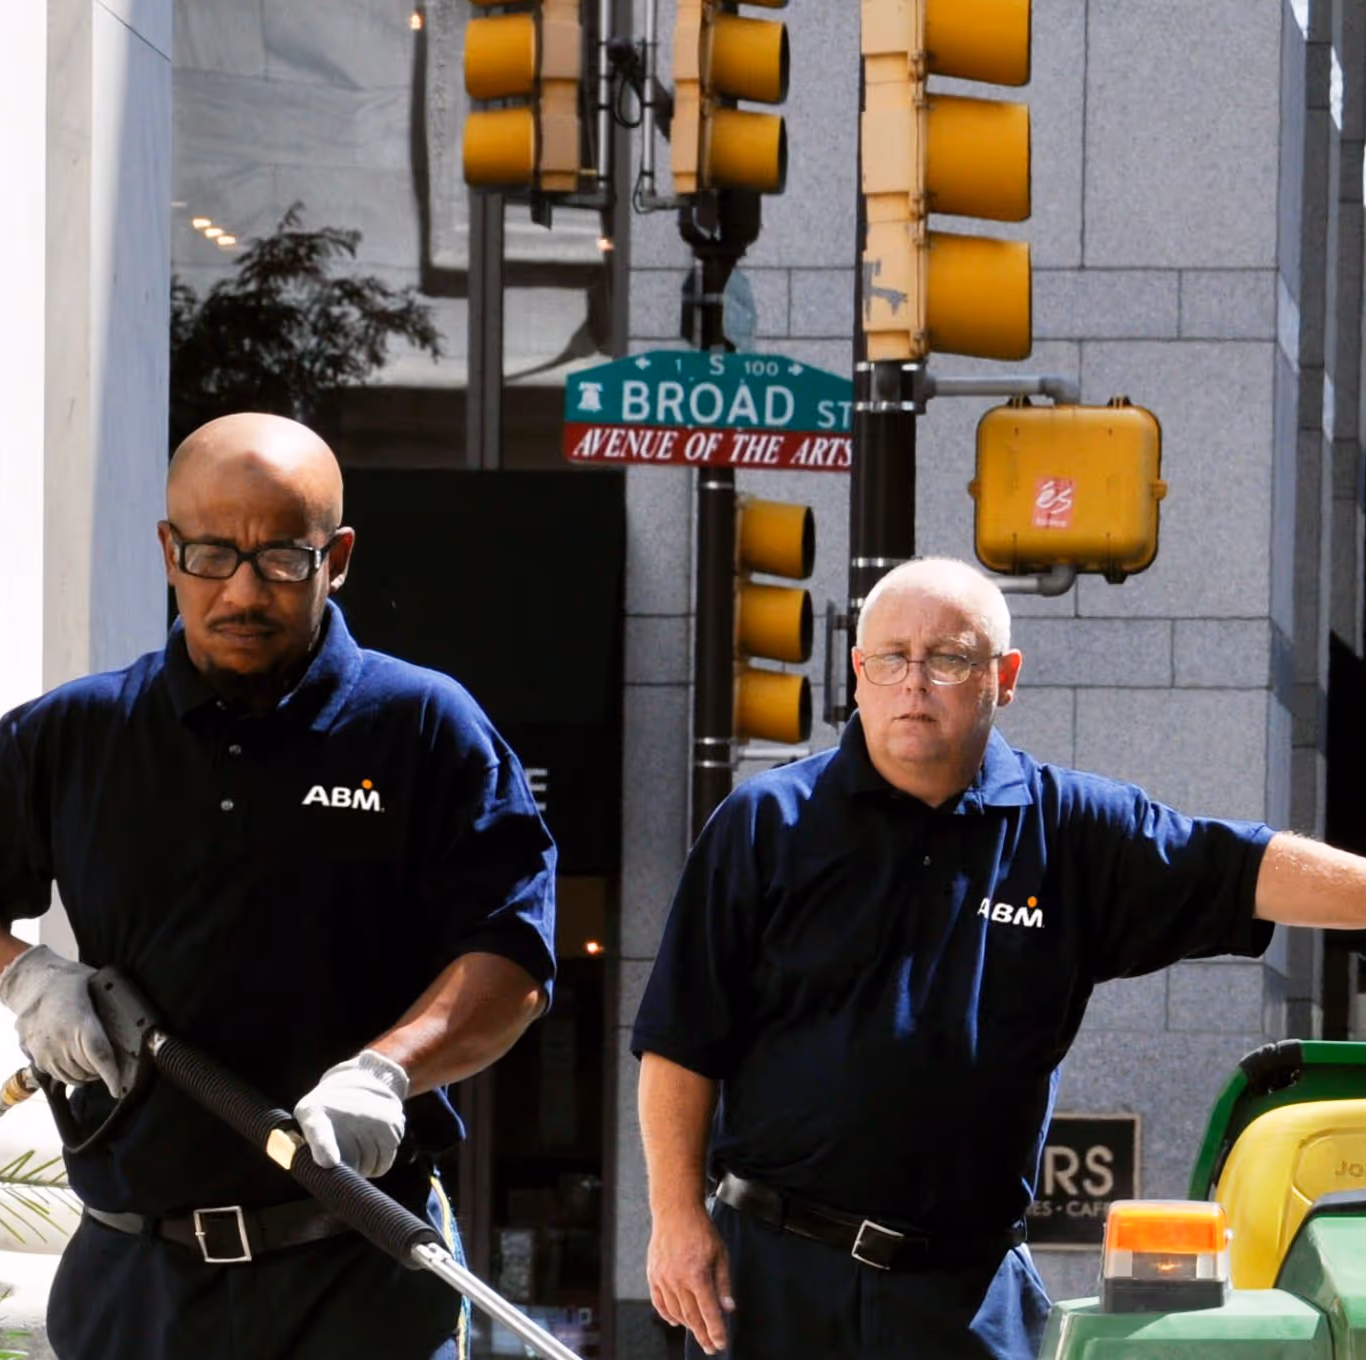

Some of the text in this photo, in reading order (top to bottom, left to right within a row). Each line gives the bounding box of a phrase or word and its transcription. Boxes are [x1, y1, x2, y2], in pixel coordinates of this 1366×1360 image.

[675, 354, 779, 377] 1 S 100
[621, 380, 852, 429] BROAD ST
[573, 428, 852, 467] AVENUE OF THE ARTS
[301, 780, 381, 812] ABM
[977, 896, 1044, 928] ABM
